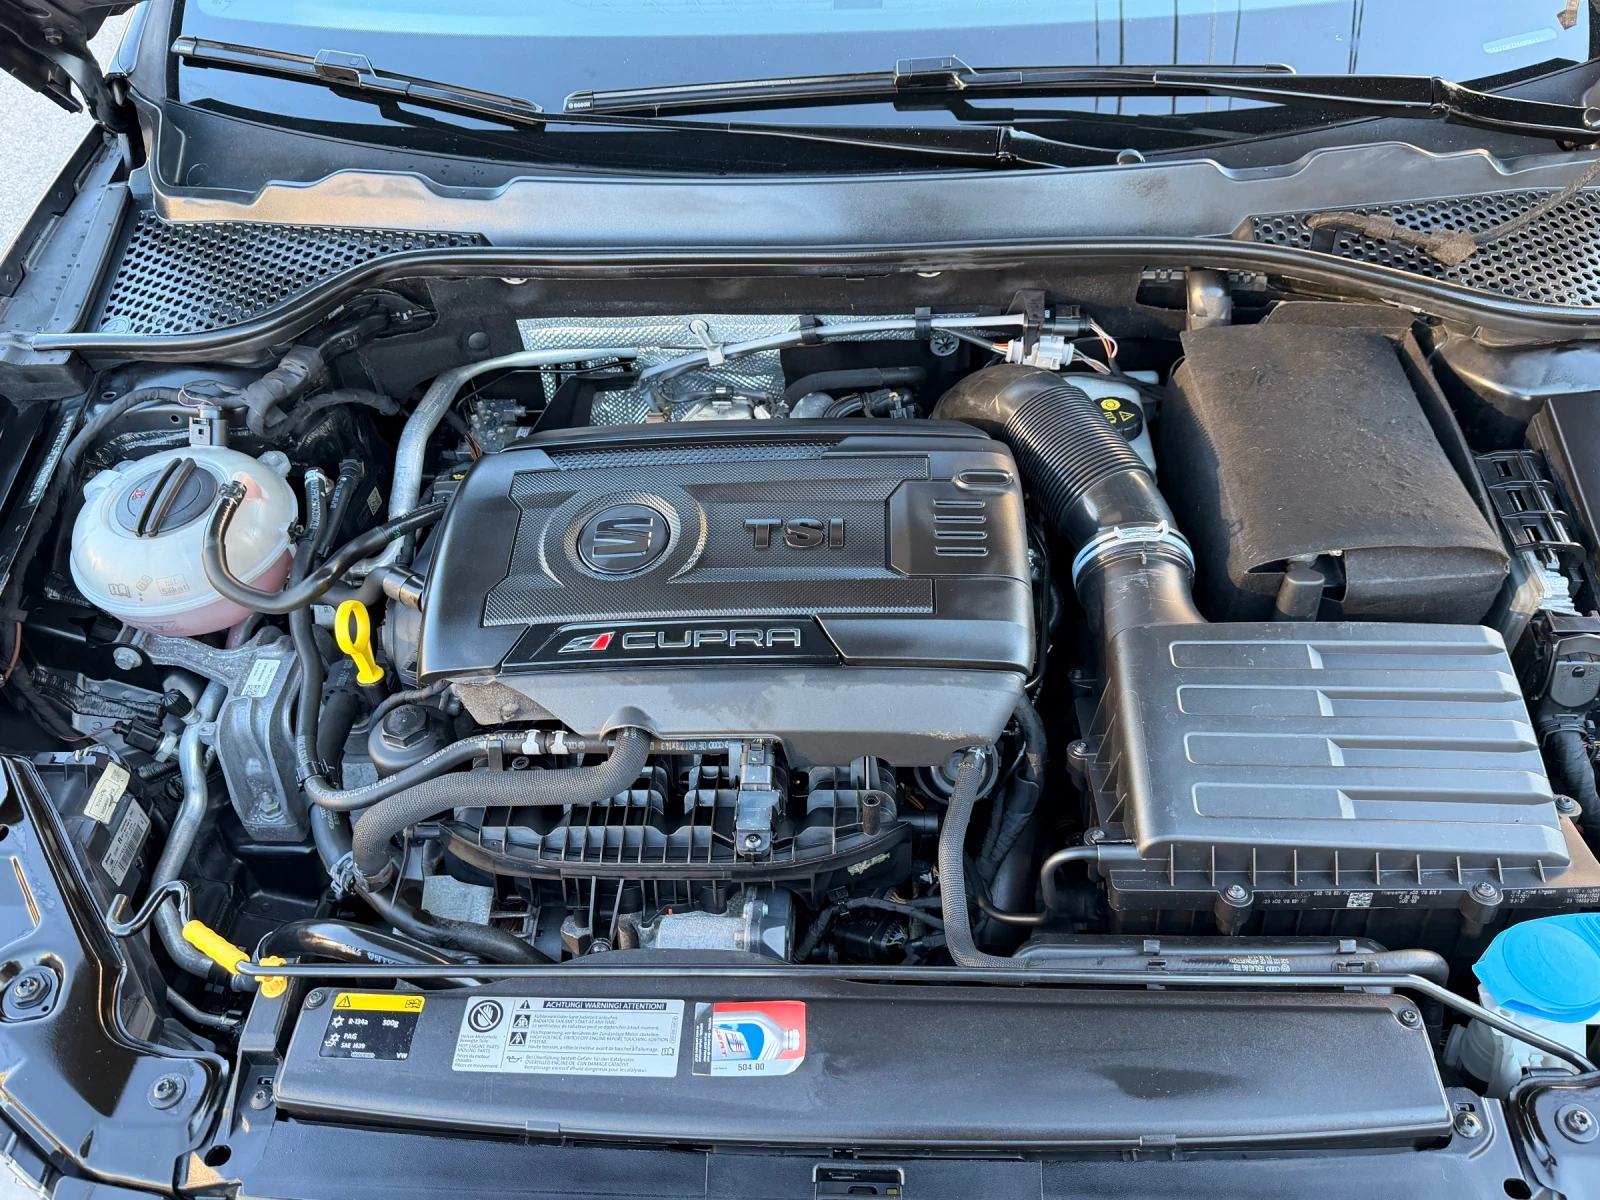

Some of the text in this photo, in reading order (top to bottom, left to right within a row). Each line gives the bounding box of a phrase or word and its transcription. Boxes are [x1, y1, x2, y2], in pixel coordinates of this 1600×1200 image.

[743, 518, 846, 549] TSI
[622, 628, 801, 650] CUPRA
[545, 1001, 665, 1010] ACHTUNG! WARNING! ATTENTION!
[737, 1063, 753, 1072] 504
[755, 1063, 766, 1072] 00
